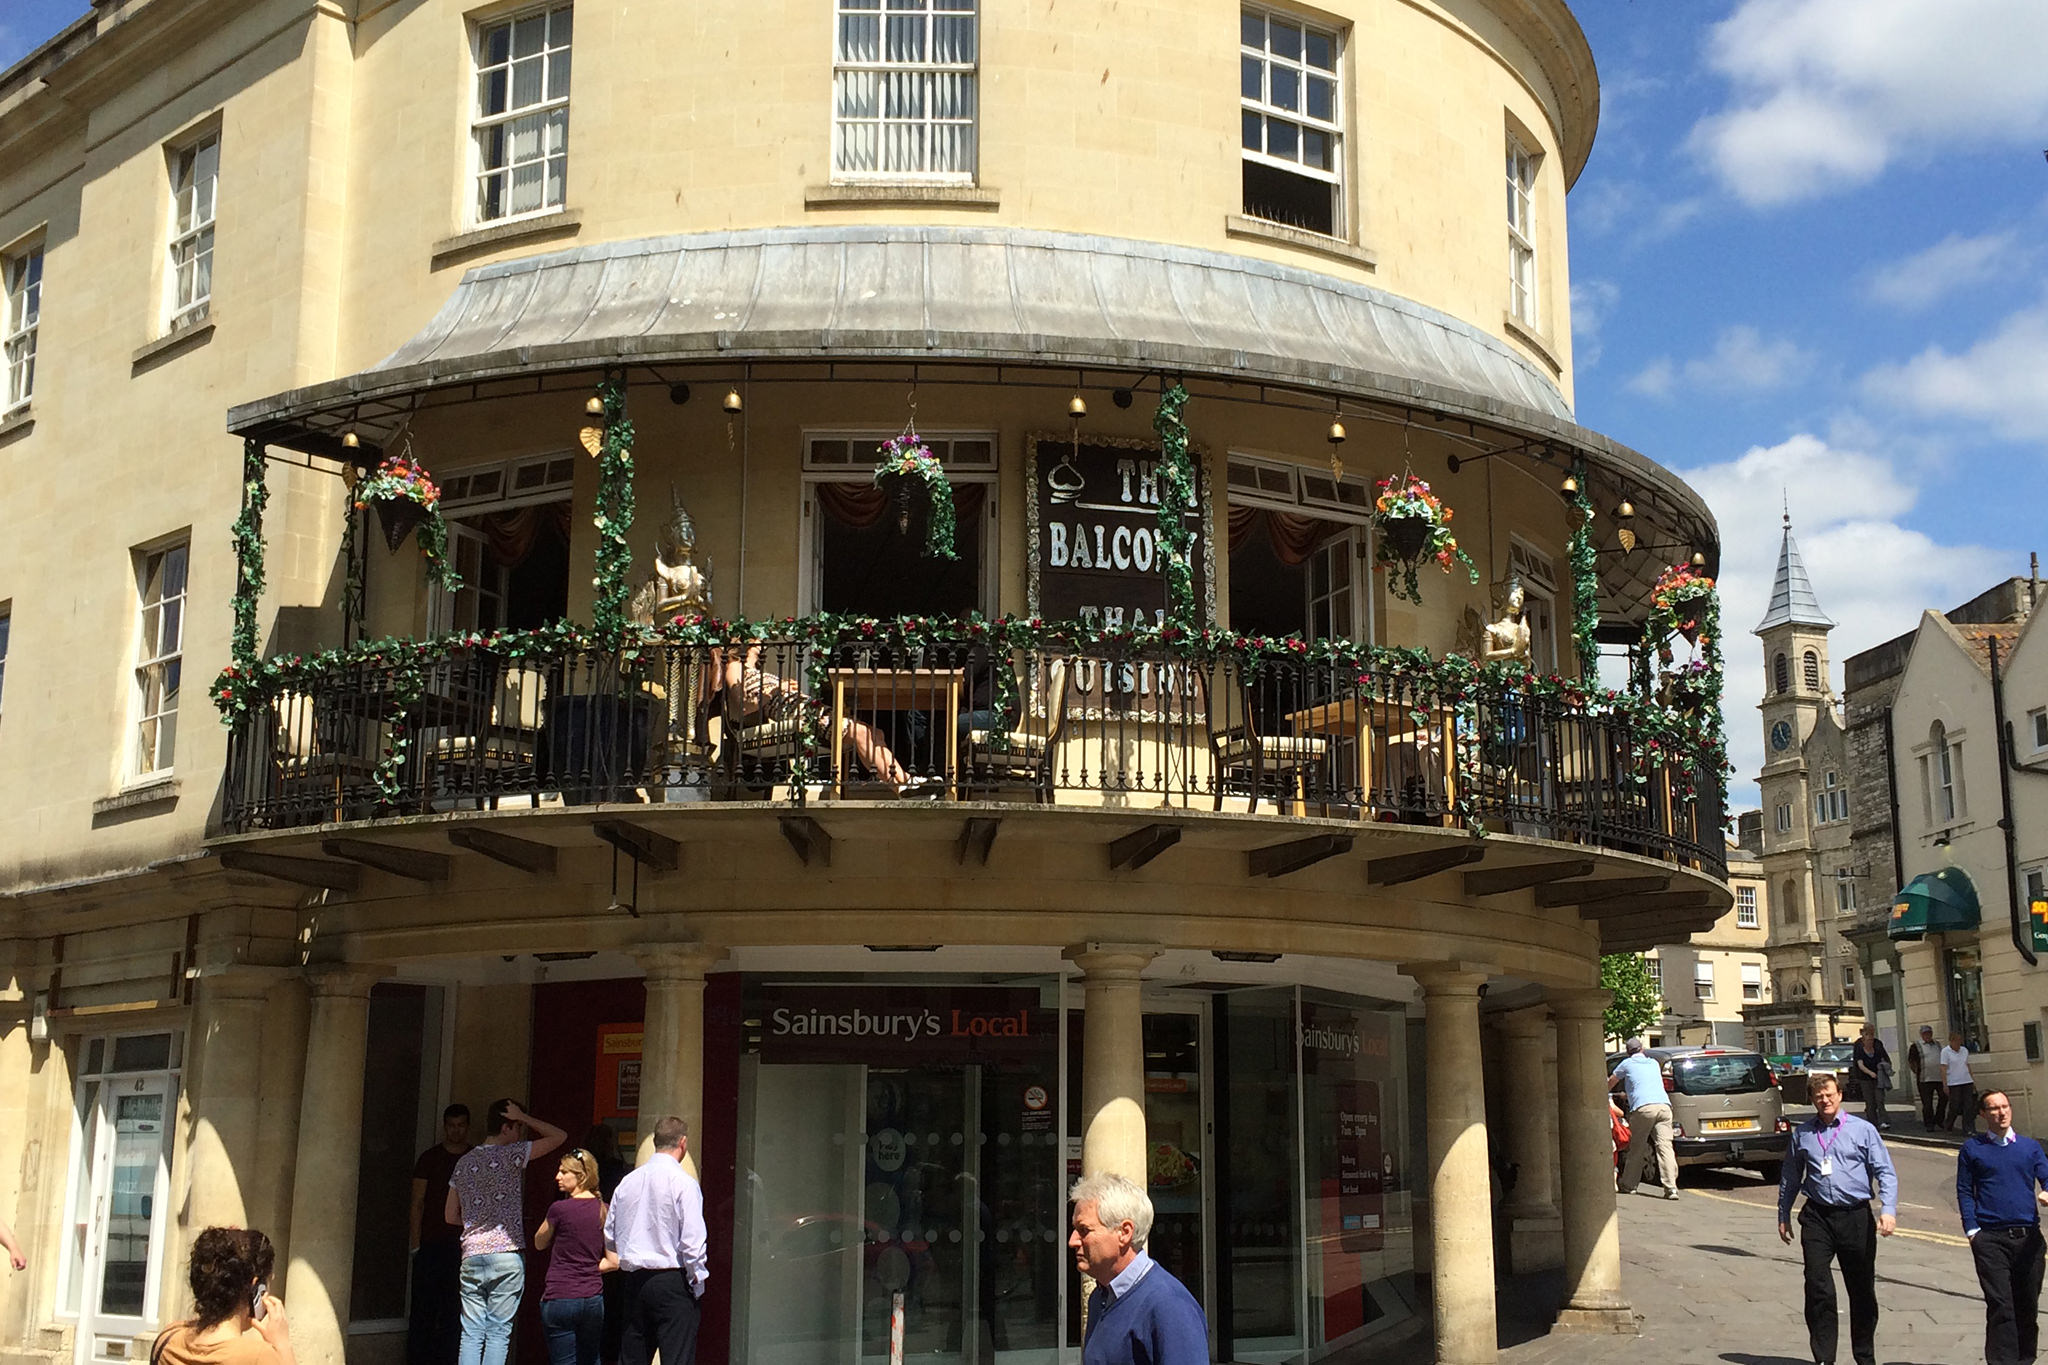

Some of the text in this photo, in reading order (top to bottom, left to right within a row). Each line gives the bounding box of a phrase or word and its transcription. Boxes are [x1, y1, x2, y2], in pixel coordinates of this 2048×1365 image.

[1117, 460, 1198, 507] THI
[772, 1008, 1029, 1041] Sainsbury's Local
[134, 1078, 145, 1092] 42
